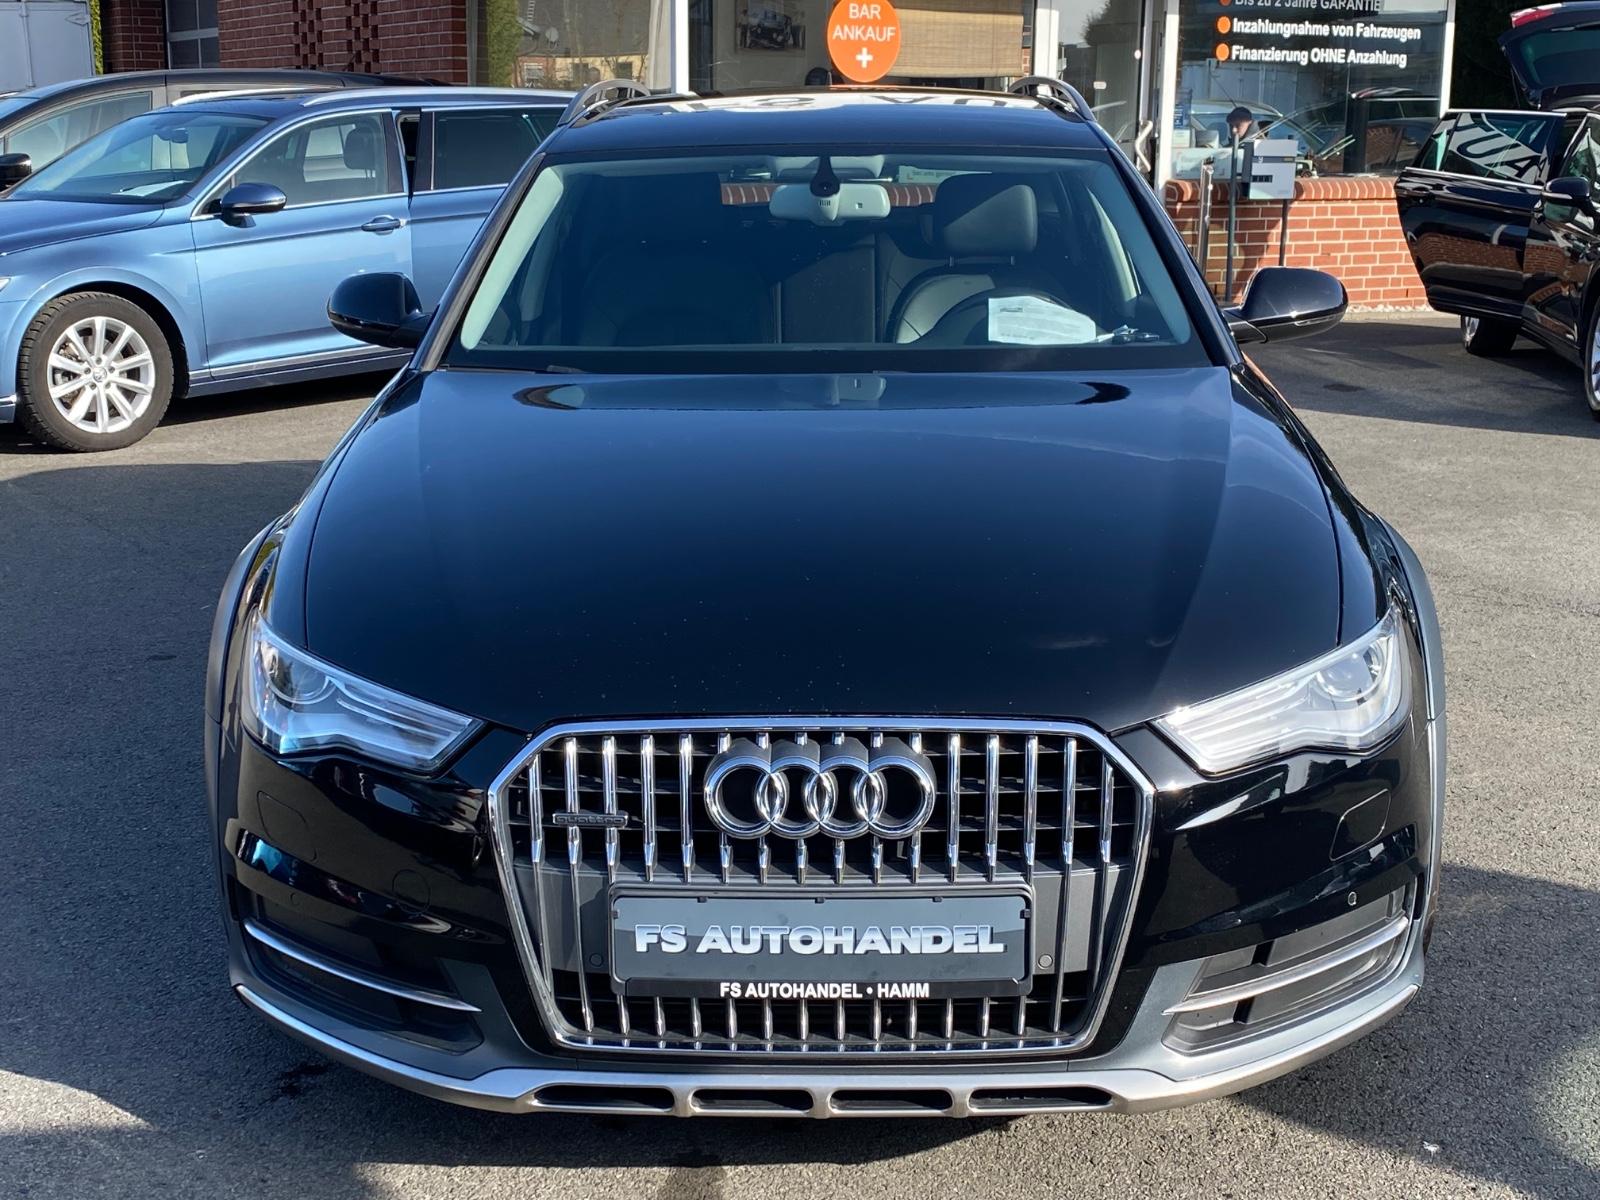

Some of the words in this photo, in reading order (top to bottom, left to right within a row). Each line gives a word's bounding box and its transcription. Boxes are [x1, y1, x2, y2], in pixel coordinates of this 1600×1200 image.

[849, 3, 881, 20] BAR
[1320, 0, 1380, 11] GARANTIE
[832, 24, 896, 42] ANKAUF
[1233, 17, 1329, 38] Inzahlungnahme
[1332, 26, 1354, 37] von
[1356, 22, 1421, 42] Fahrzeugen
[1231, 45, 1308, 65] Finanzierung
[1310, 47, 1345, 63] OHNE
[1347, 49, 1407, 68] Anzahlung
[556, 815, 624, 824] quattro
[635, 924, 687, 953] FS
[697, 924, 1006, 955] AUTOHANDEL
[719, 982, 742, 998] FS
[745, 982, 862, 999] AUTOHANDEL
[877, 982, 930, 998] HAMM
